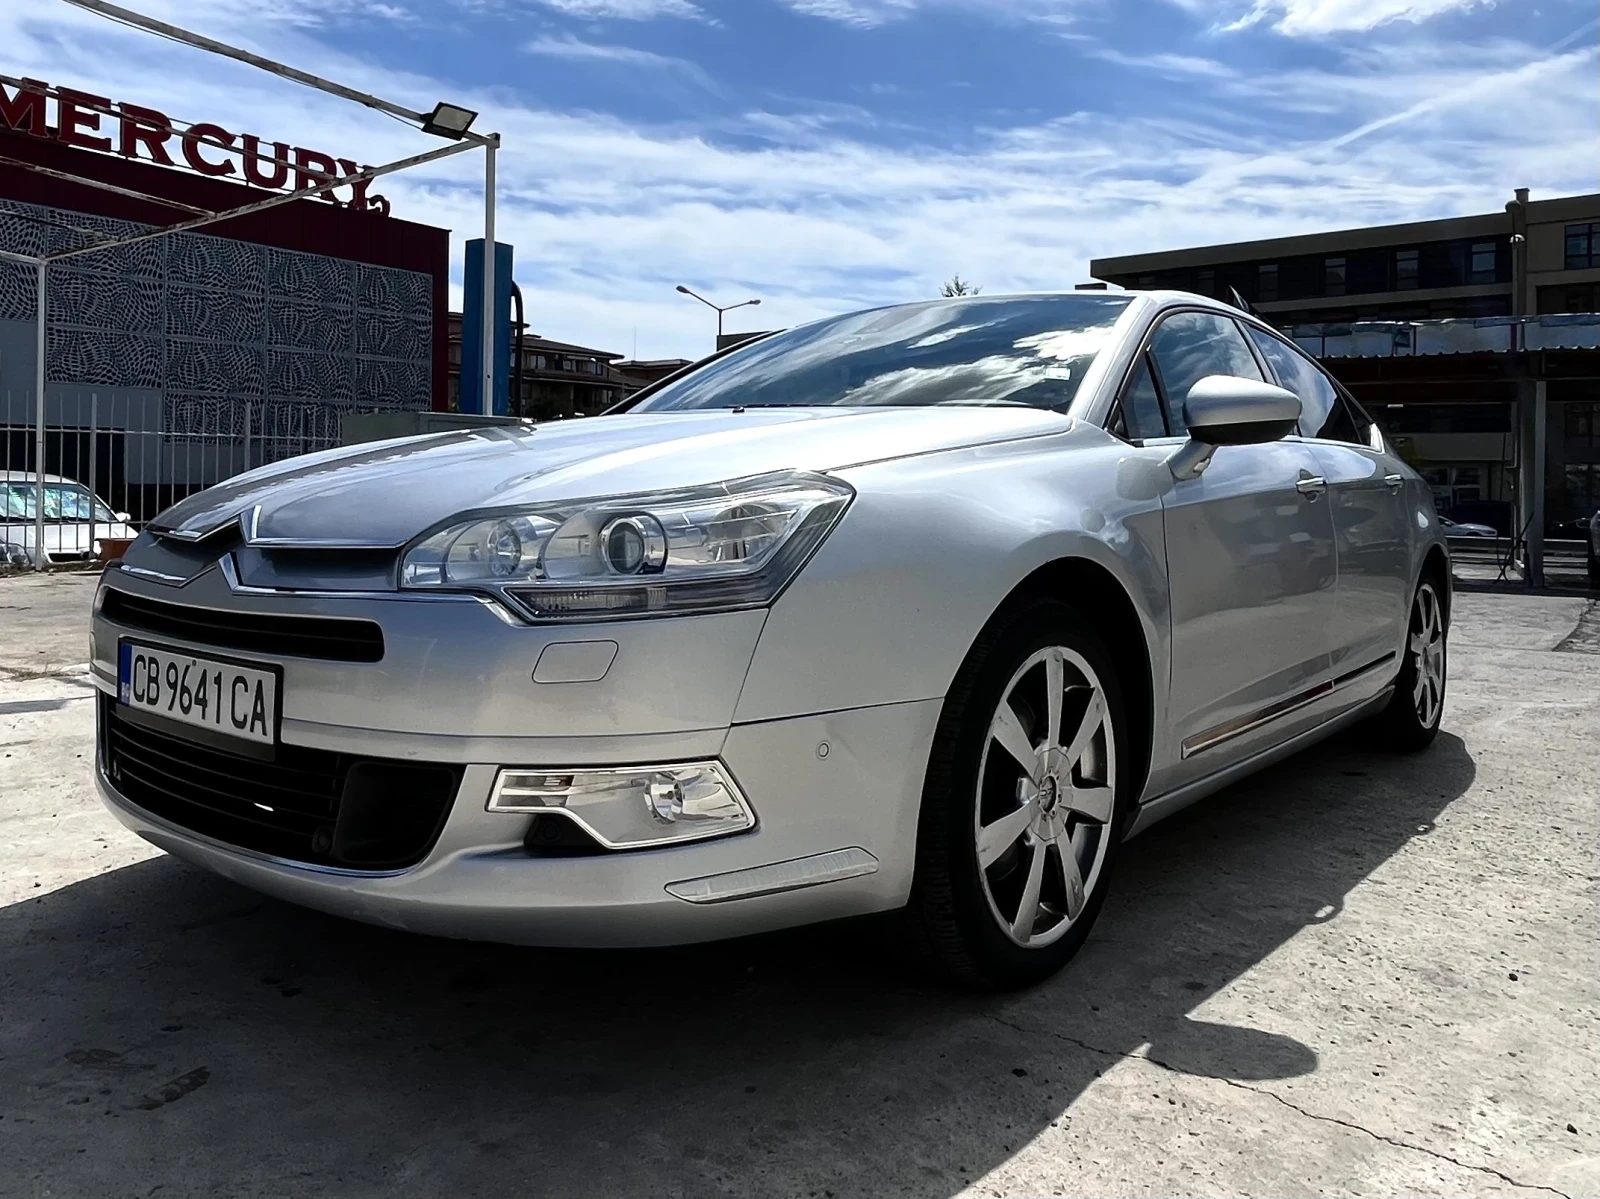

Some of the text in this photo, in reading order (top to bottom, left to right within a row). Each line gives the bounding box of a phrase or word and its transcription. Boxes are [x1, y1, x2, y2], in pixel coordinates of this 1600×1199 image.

[0, 77, 380, 213] MERCURY
[165, 661, 222, 724] 9641
[231, 675, 268, 736] CA
